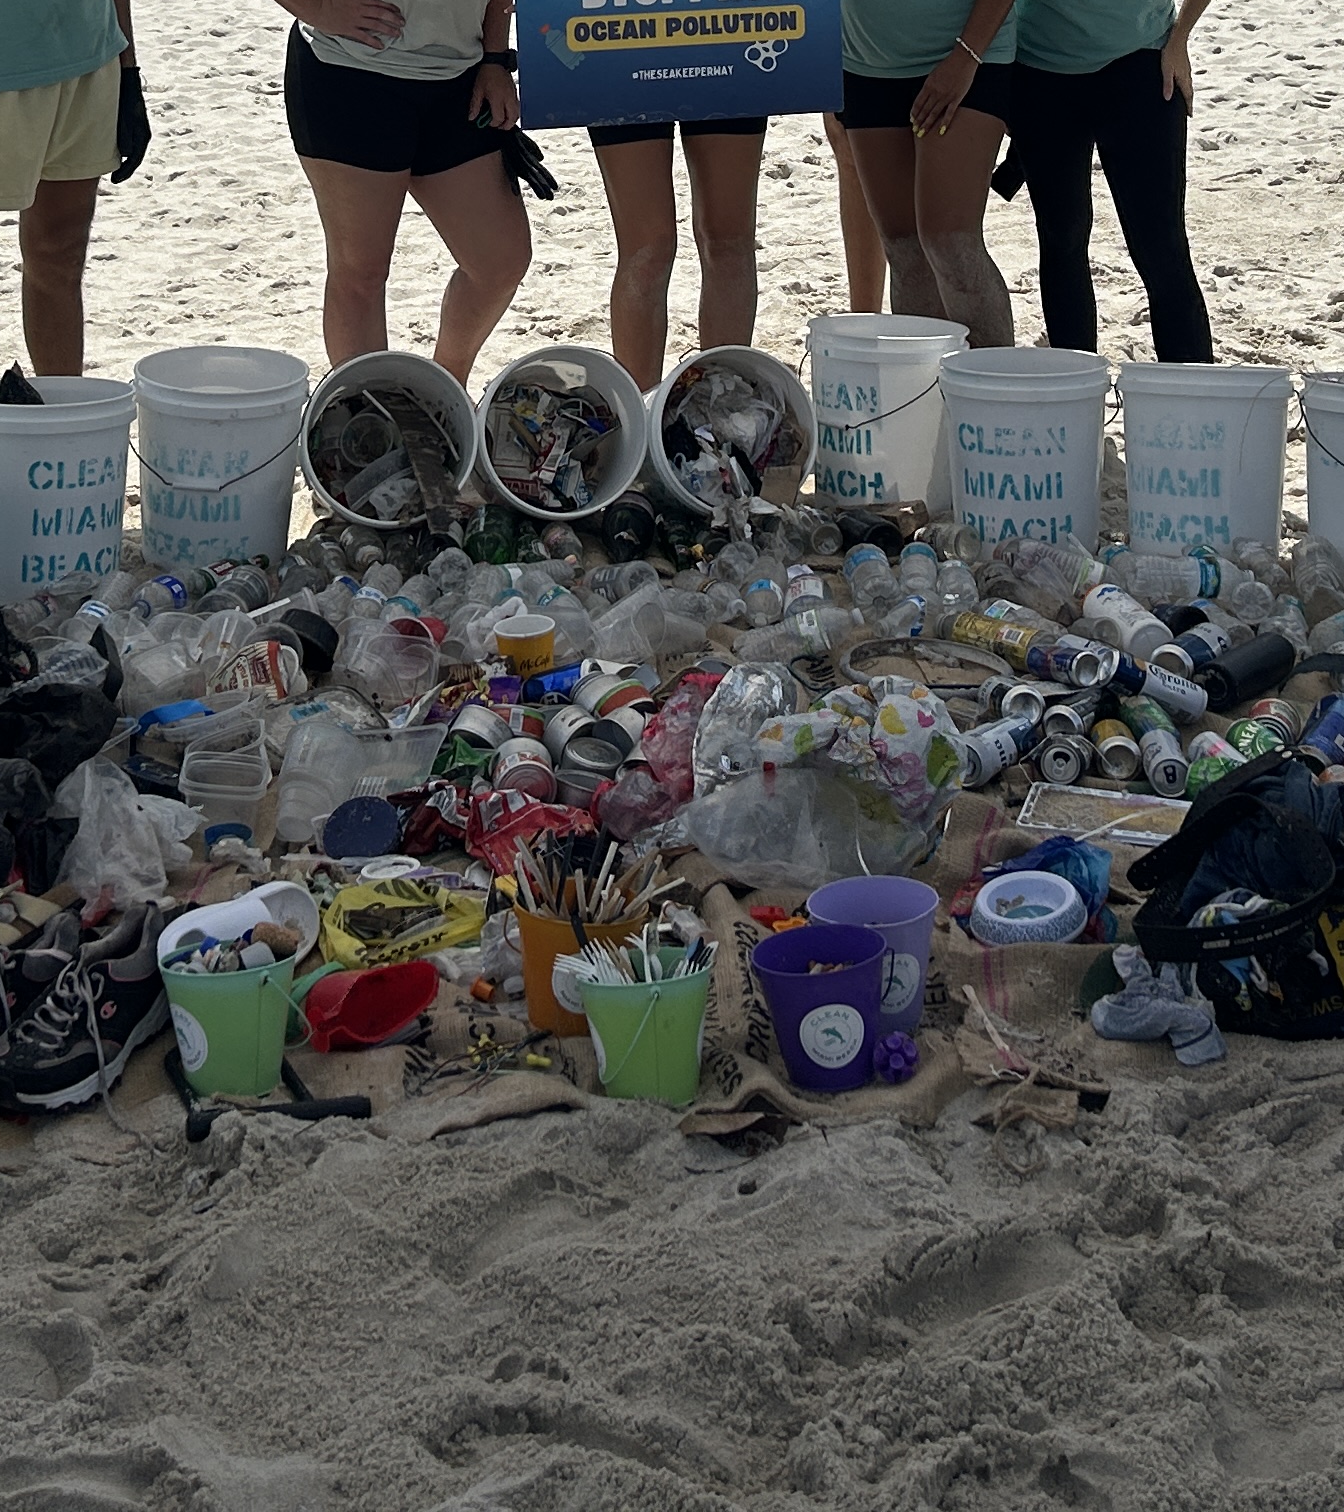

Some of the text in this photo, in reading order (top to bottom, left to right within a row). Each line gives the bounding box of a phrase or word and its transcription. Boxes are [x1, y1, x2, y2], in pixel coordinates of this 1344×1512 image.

[573, 10, 798, 43] OCEAN POLLUTION
[958, 422, 1068, 456] CLEAN
[964, 472, 1063, 501] MIAMI
[962, 510, 1073, 544] BEACH
[809, 1010, 851, 1032] CLEAN
